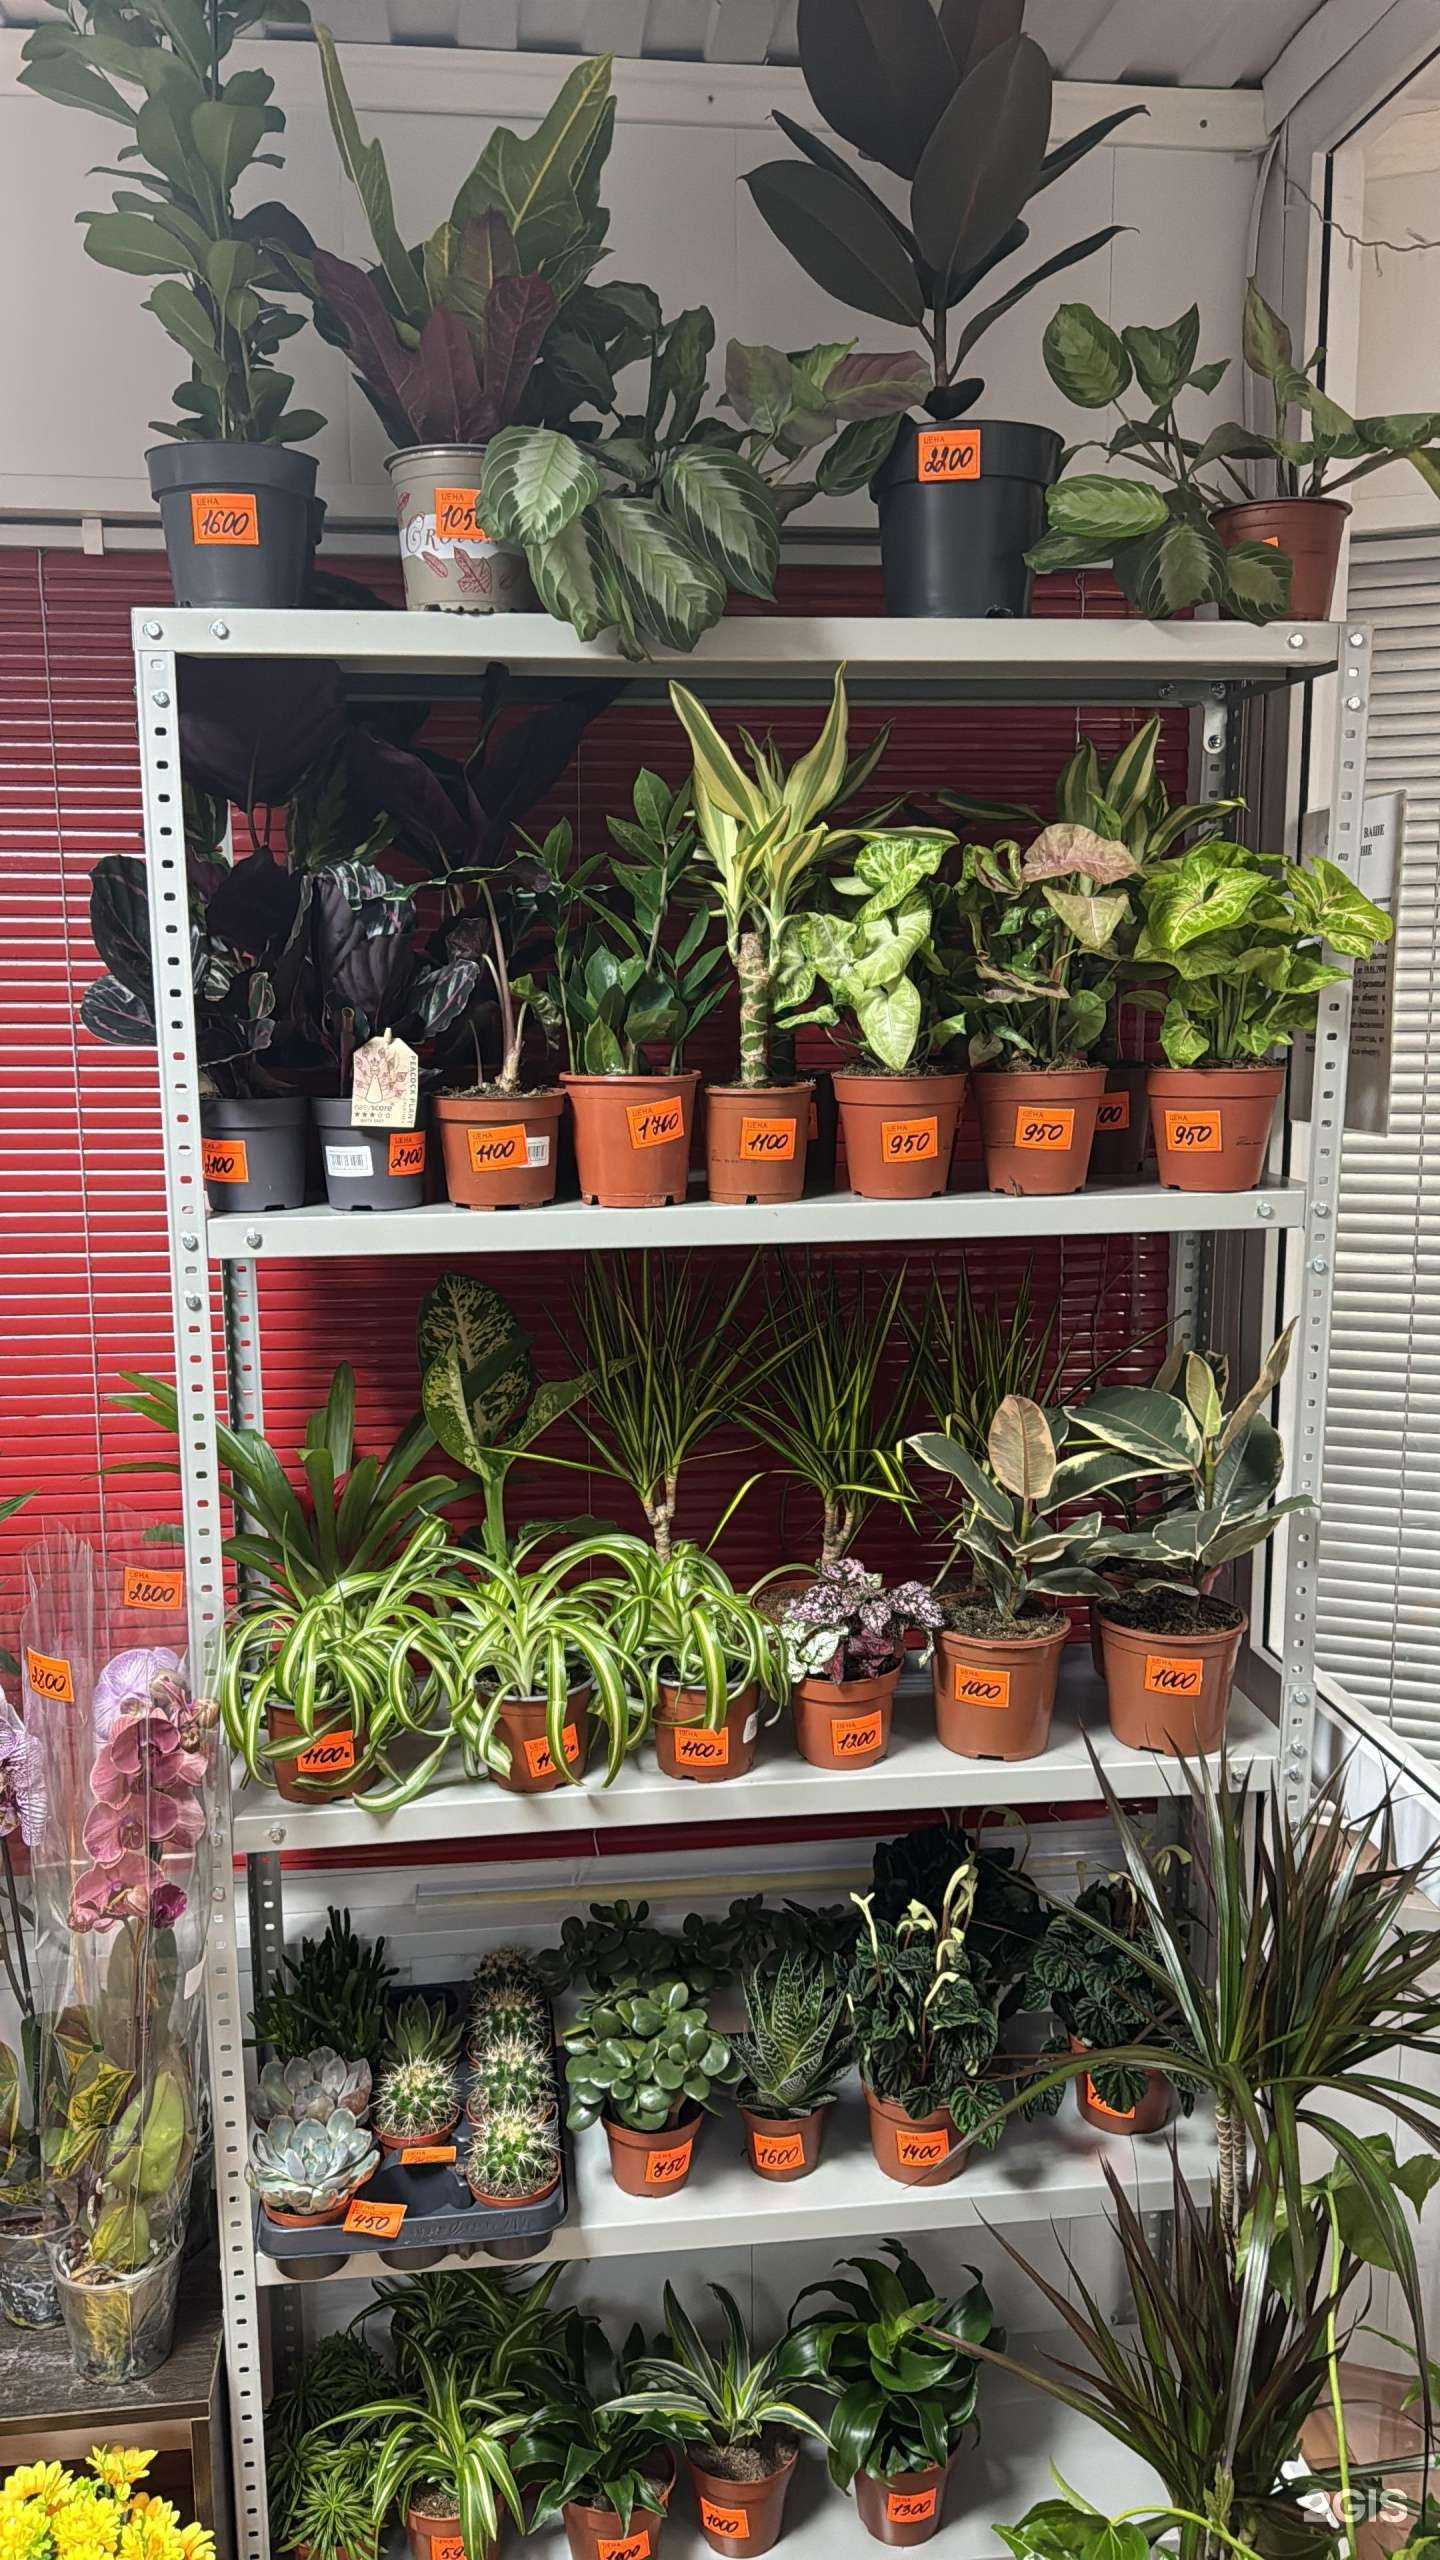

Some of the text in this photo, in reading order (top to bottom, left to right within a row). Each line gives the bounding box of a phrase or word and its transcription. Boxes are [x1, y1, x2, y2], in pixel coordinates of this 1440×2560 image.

[924, 447, 974, 473] 2200
[196, 498, 219, 506] ЦЕНА
[441, 493, 464, 502] ЦЕНА
[202, 509, 249, 536] 1600
[441, 504, 483, 531] 105
[748, 1133, 788, 1152] 1100
[1022, 1123, 1063, 1142] 950
[1174, 1125, 1212, 1146] 950
[477, 1140, 515, 1163] 1100
[890, 1132, 930, 1154] 950
[391, 1147, 423, 1169] 2100
[129, 1582, 174, 1602] 2800
[1152, 1669, 1197, 1689] 1000
[961, 1680, 1000, 1699] 1000
[838, 1729, 876, 1750] 1200
[758, 2147, 799, 2165] 1600
[902, 2144, 941, 2161] 1400
[353, 2215, 390, 2231] 450
[893, 2499, 932, 2516] 1300
